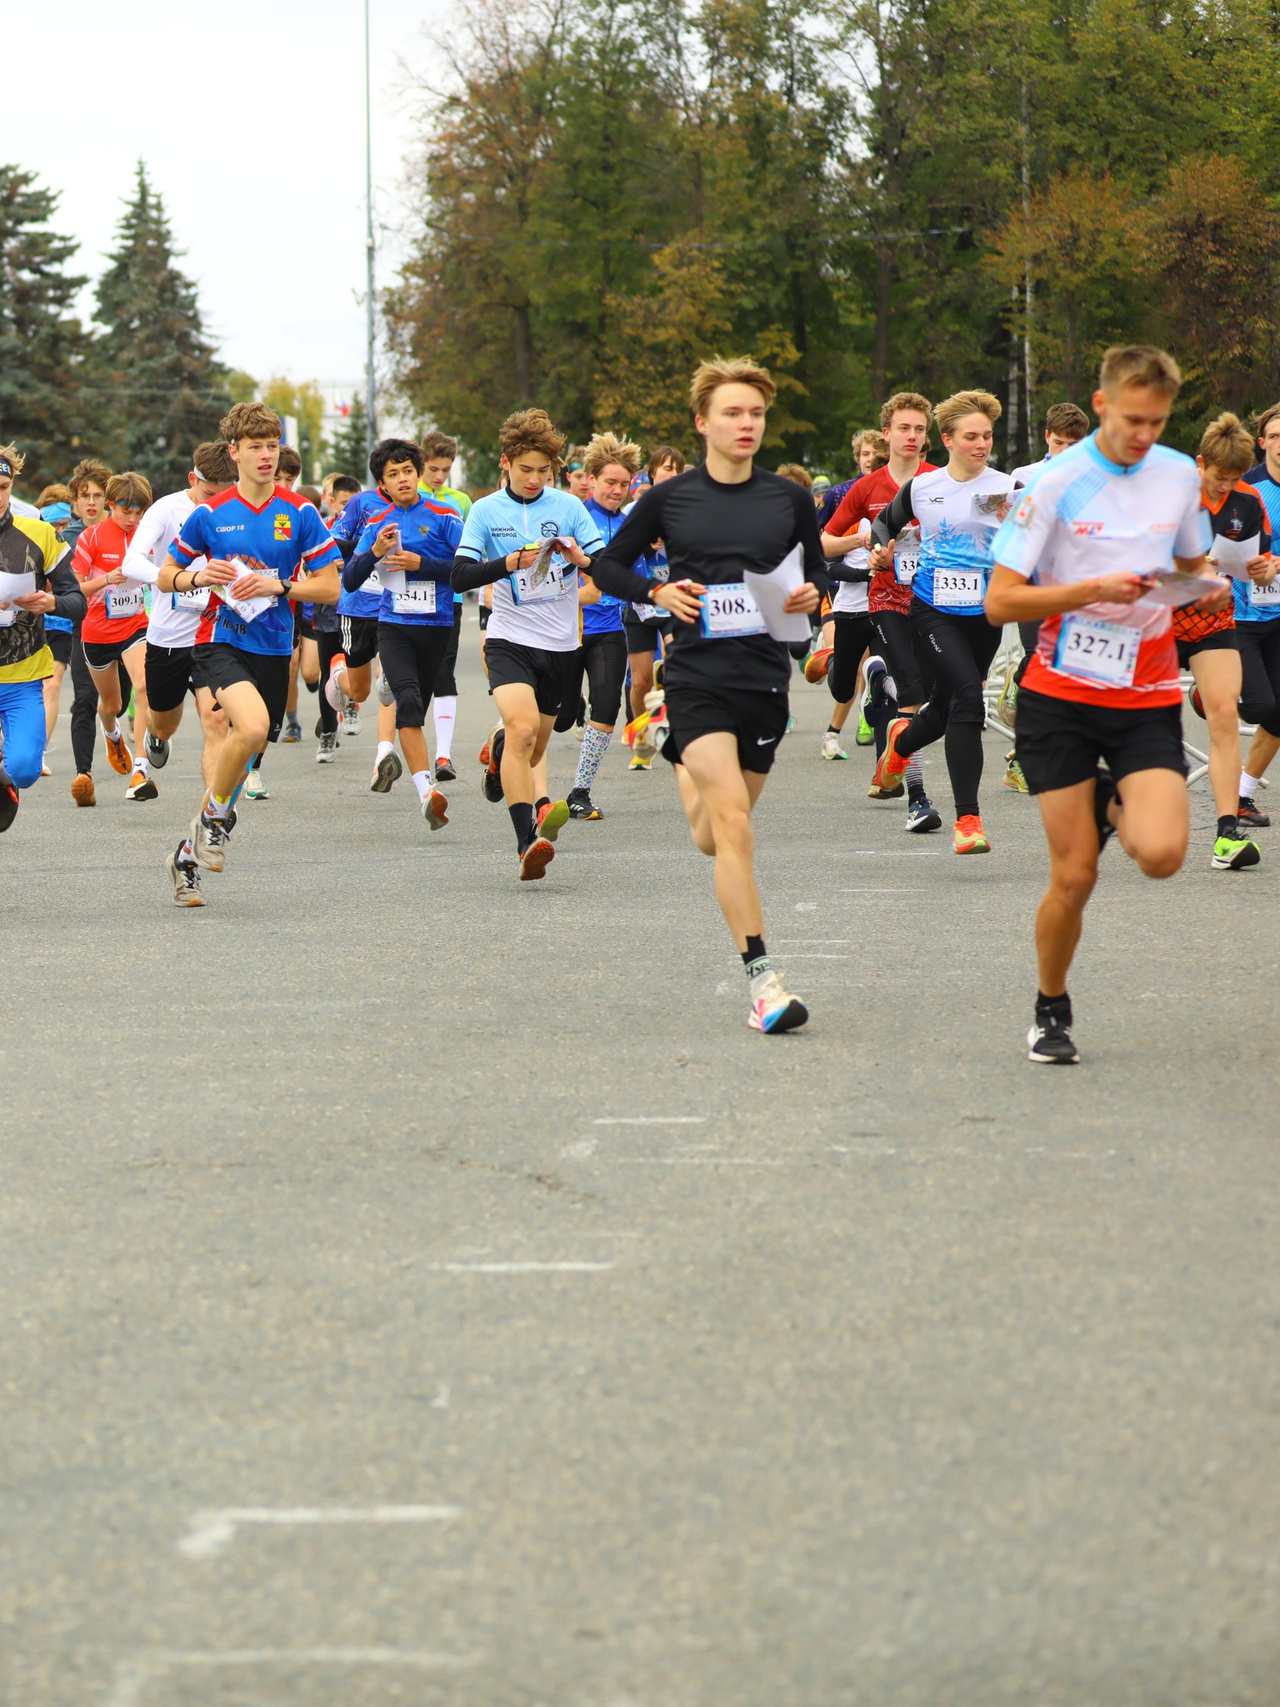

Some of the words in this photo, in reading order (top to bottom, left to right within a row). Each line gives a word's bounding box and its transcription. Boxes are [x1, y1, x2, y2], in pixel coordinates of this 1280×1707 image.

[215, 525, 236, 533] СШОР
[519, 571, 556, 591] 3.1
[940, 577, 979, 591] 333.1
[1252, 583, 1280, 595] 316.
[111, 594, 139, 608] 309.1
[709, 598, 759, 617] 308.
[235, 622, 247, 635] 18
[1068, 632, 1125, 661] 327.1
